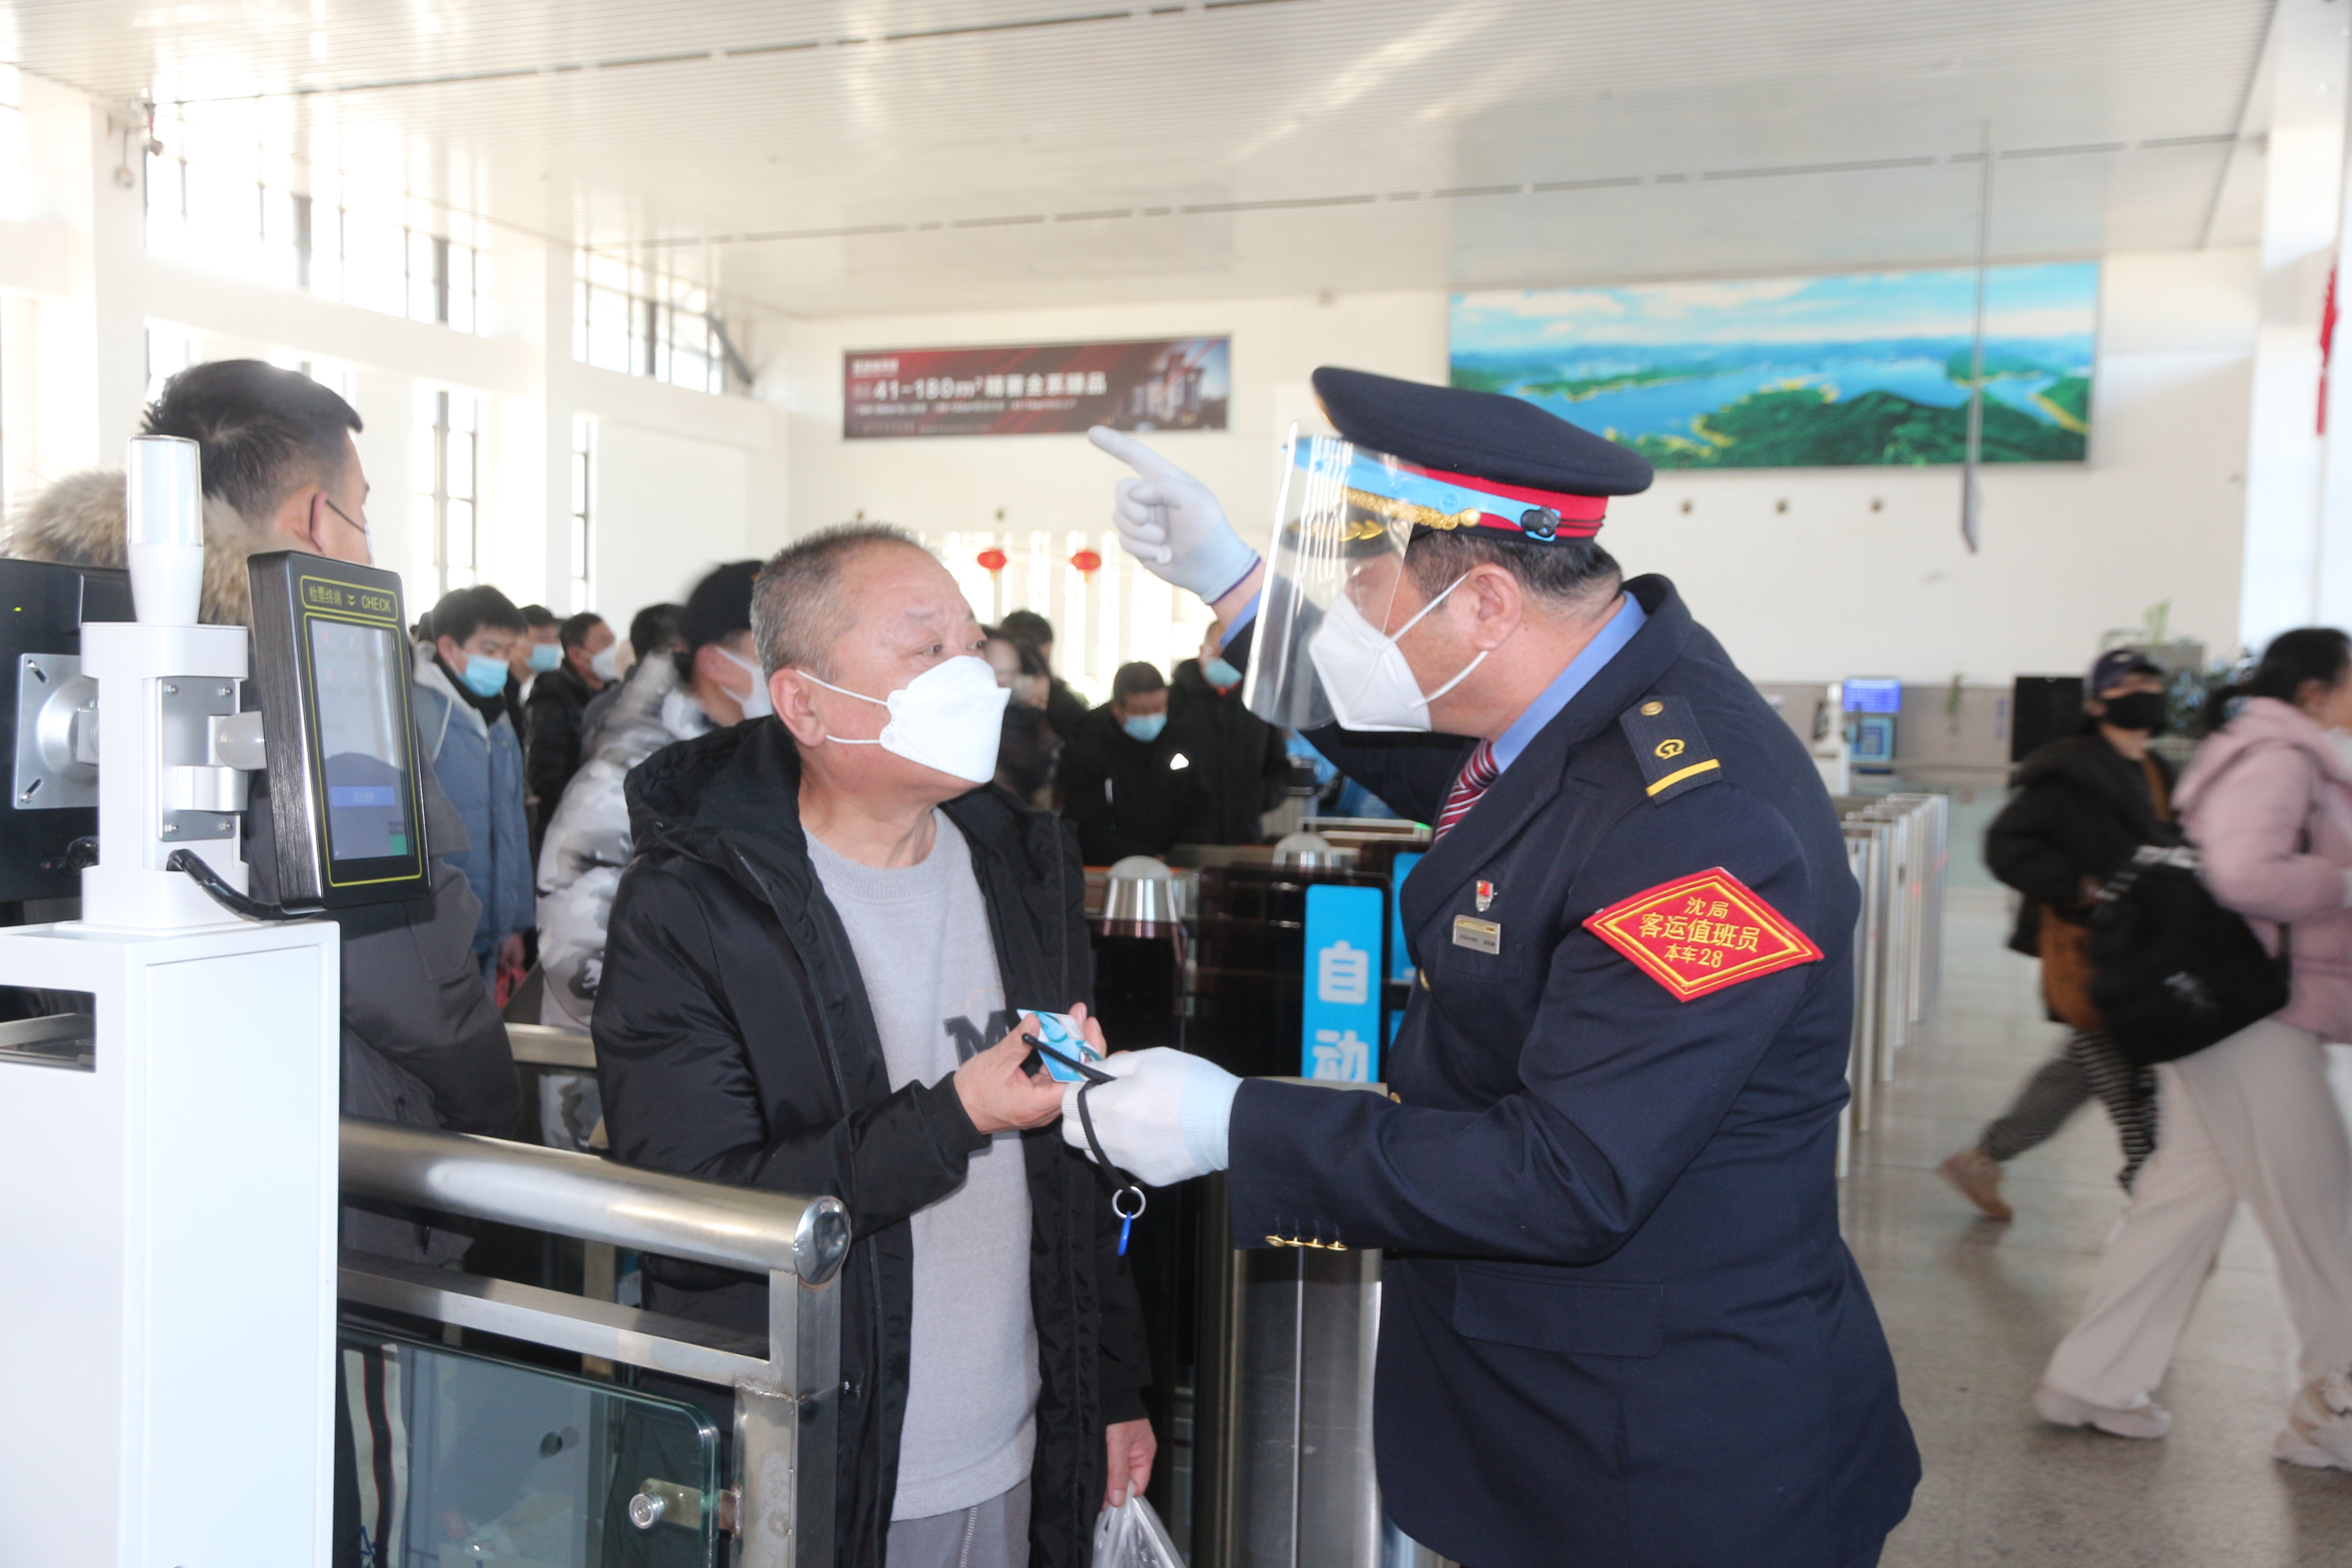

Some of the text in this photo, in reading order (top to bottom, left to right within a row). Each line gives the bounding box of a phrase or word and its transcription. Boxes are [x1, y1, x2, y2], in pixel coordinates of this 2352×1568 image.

[309, 585, 342, 606] 检票终端
[362, 595, 392, 613] CHECK
[1684, 896, 1730, 919] 沈局
[1638, 912, 1761, 953] 客运值班员
